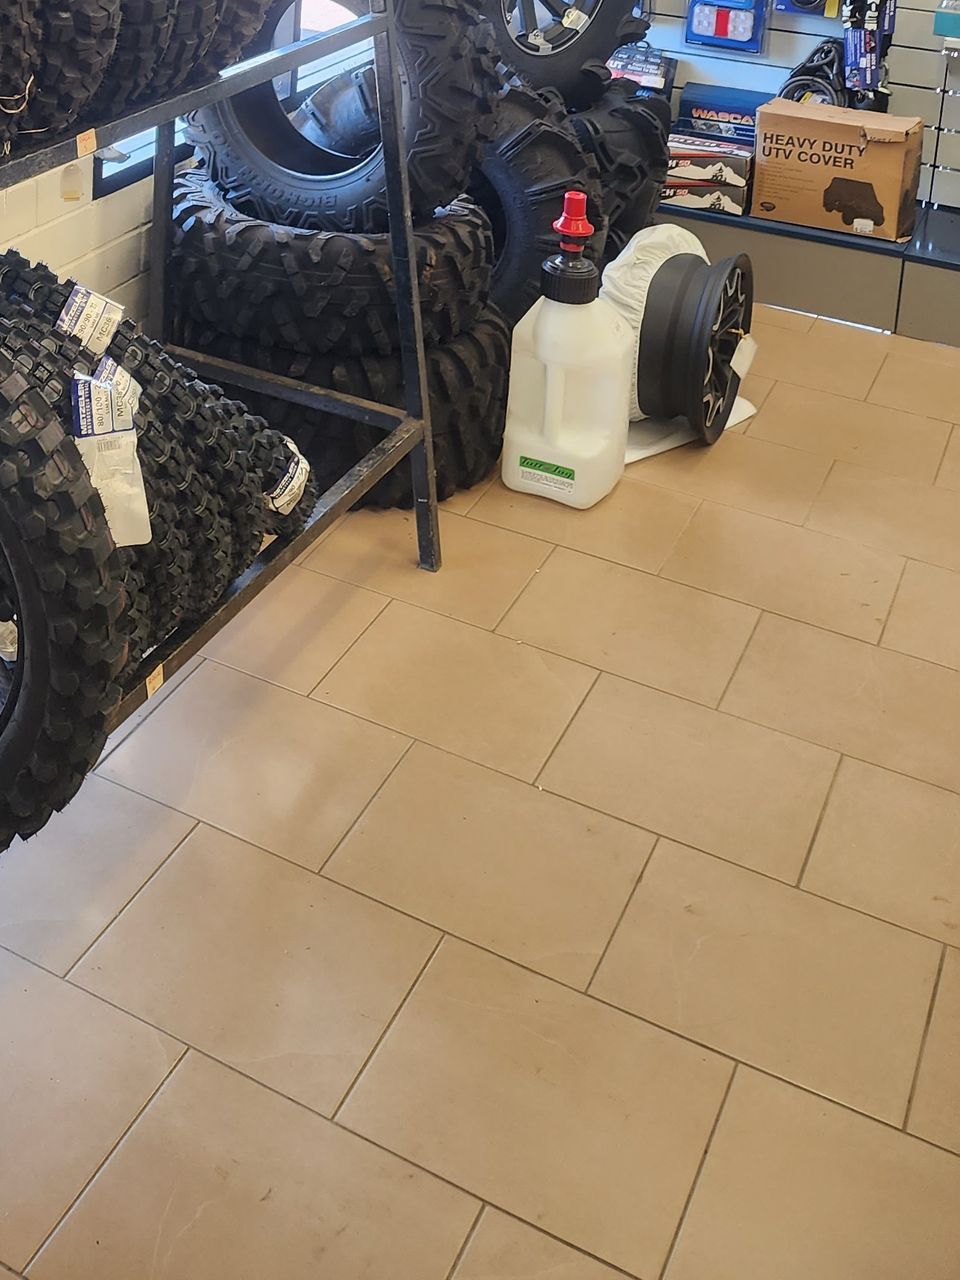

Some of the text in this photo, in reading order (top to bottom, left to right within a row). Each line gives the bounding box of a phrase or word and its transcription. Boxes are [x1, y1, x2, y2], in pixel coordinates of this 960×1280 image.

[761, 145, 855, 170] UTV COVER
[763, 132, 866, 158] HEAVY DUTY
[77, 380, 87, 435] METZELER
